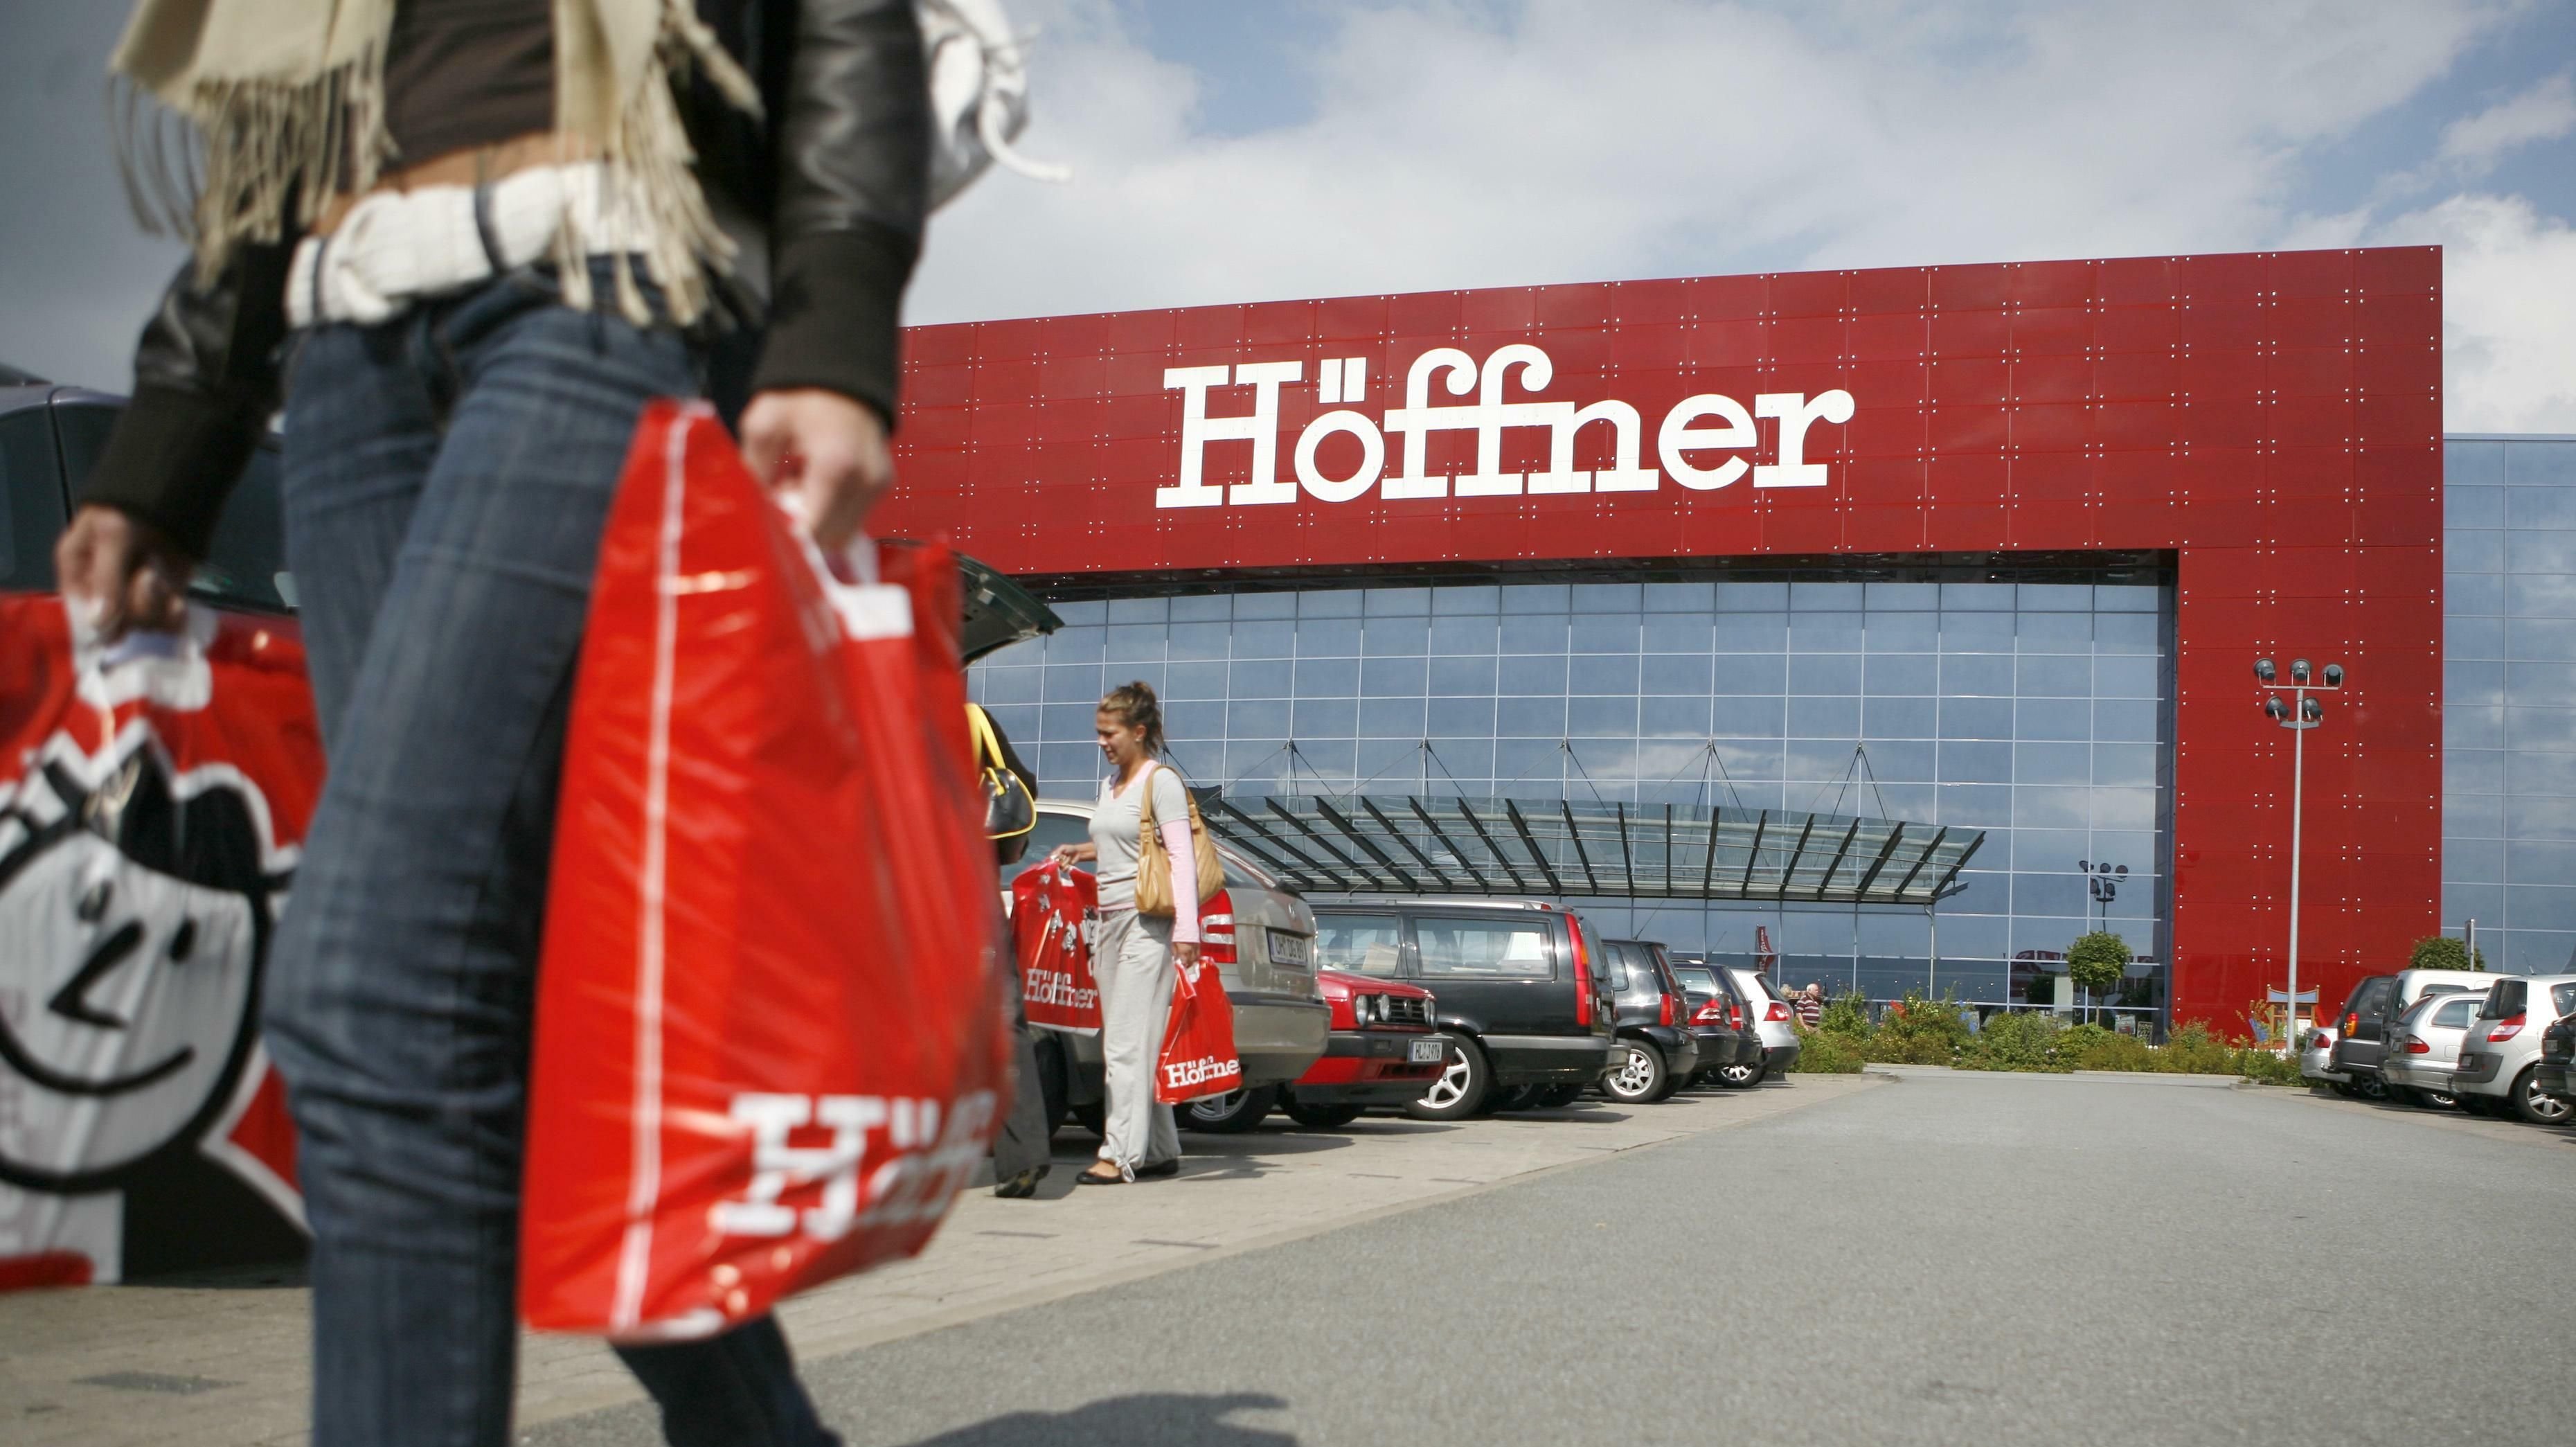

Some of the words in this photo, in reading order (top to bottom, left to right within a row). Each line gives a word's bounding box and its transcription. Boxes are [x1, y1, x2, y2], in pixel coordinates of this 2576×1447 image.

[1156, 342, 1855, 508] Höffner
[1024, 968, 1098, 1009] Höffner
[1165, 1056, 1241, 1088] Höffne
